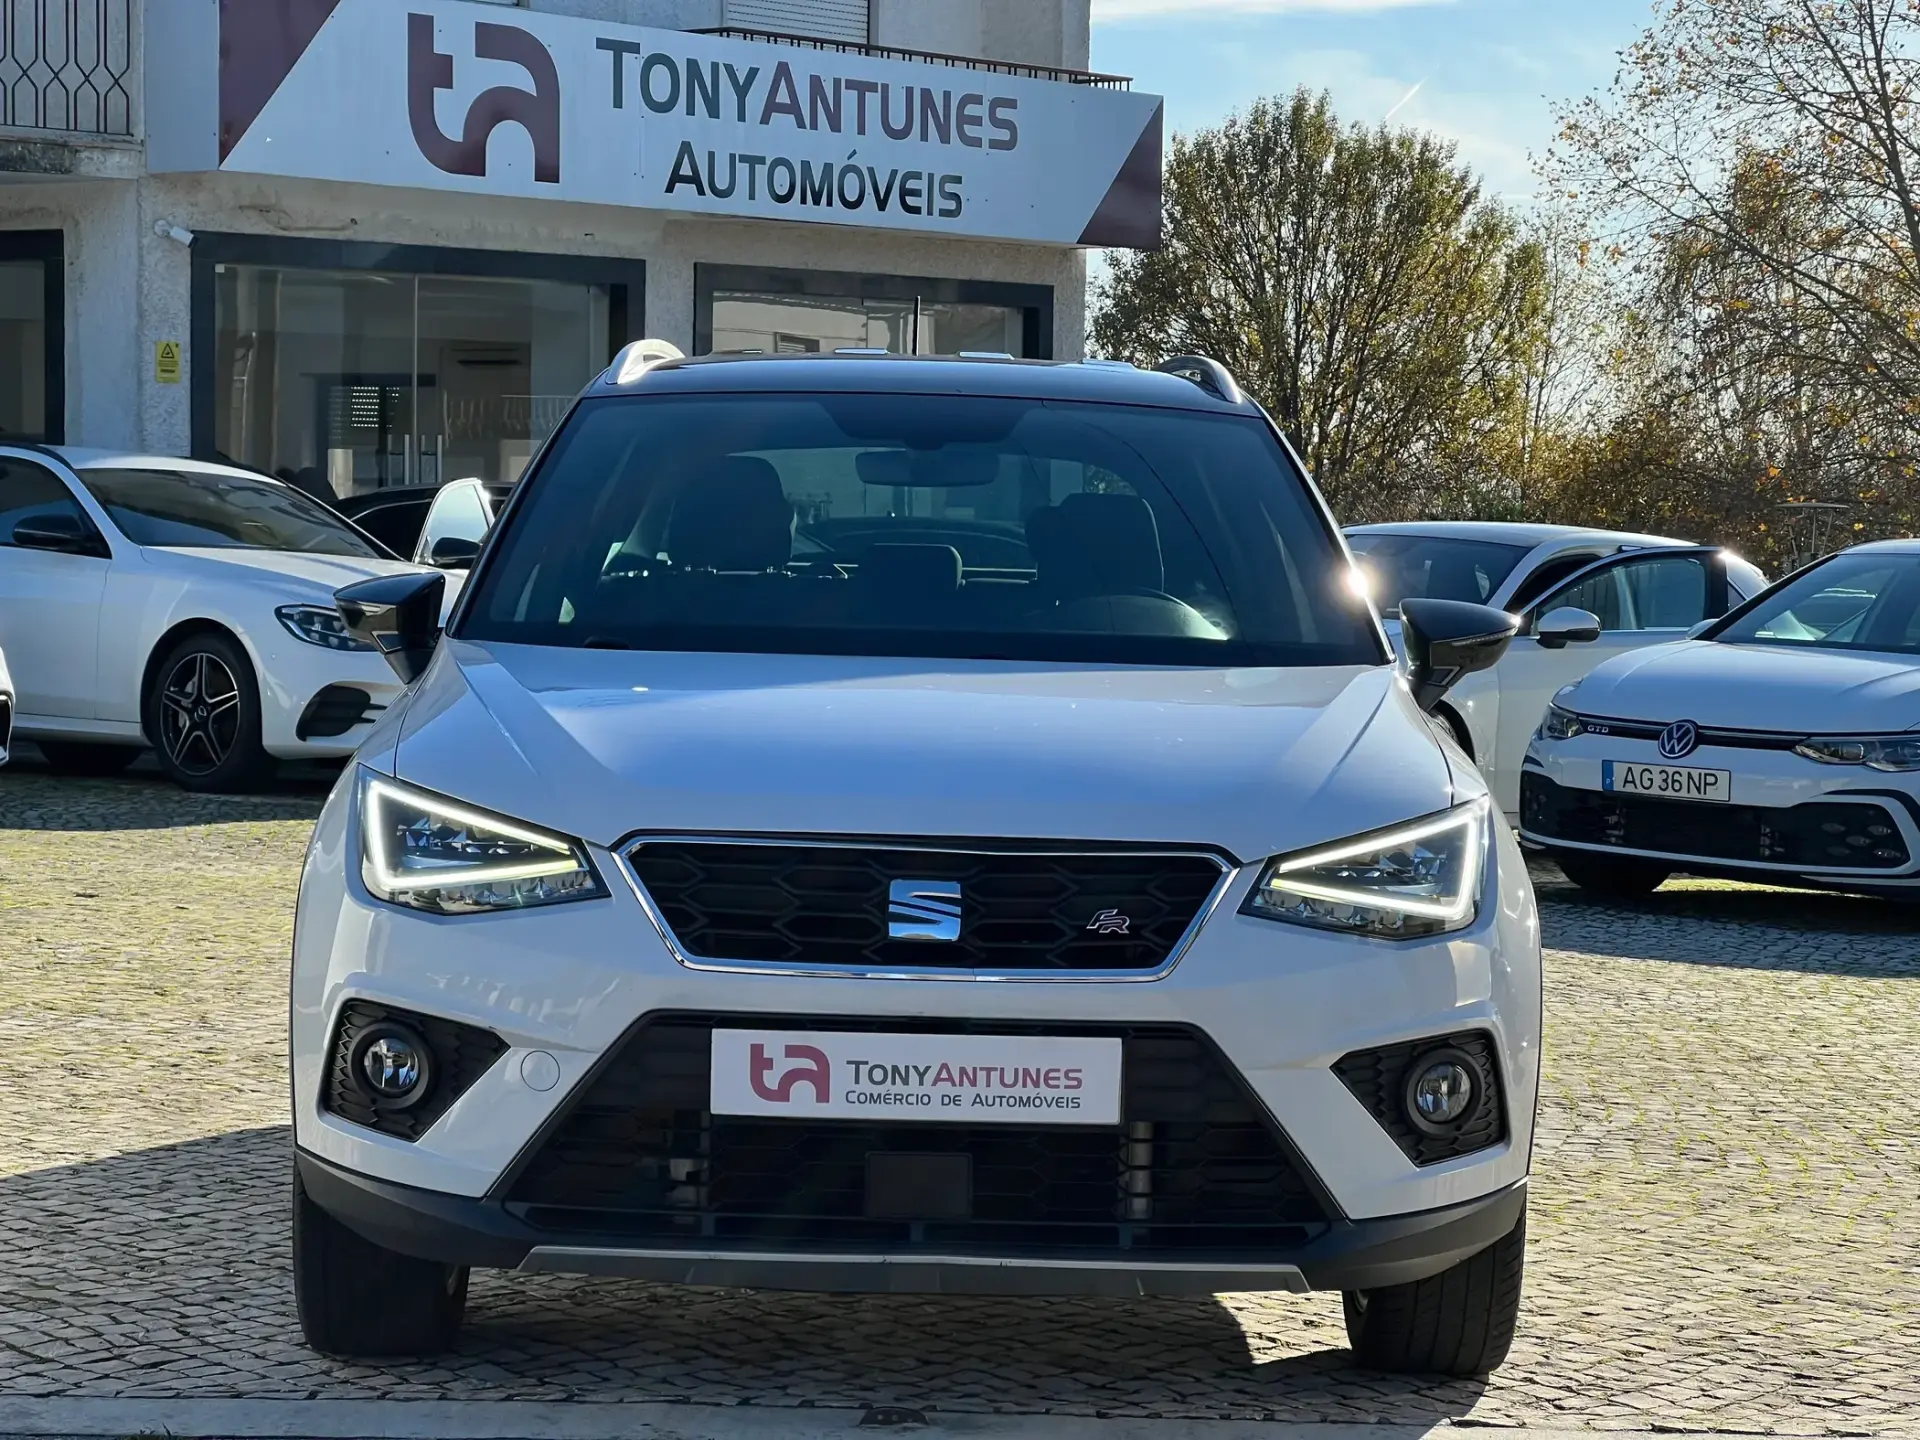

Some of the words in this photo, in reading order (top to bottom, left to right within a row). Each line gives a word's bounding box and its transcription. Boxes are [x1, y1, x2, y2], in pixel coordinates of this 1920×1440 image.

[664, 140, 964, 219] AUTOMÓVEIS
[1587, 724, 1609, 733] GTD
[1086, 908, 1130, 934] FR
[845, 1089, 931, 1106] COMÉRCIO
[941, 1093, 962, 1107] DE
[971, 1092, 1081, 1109] AUTOMÓVEIS
